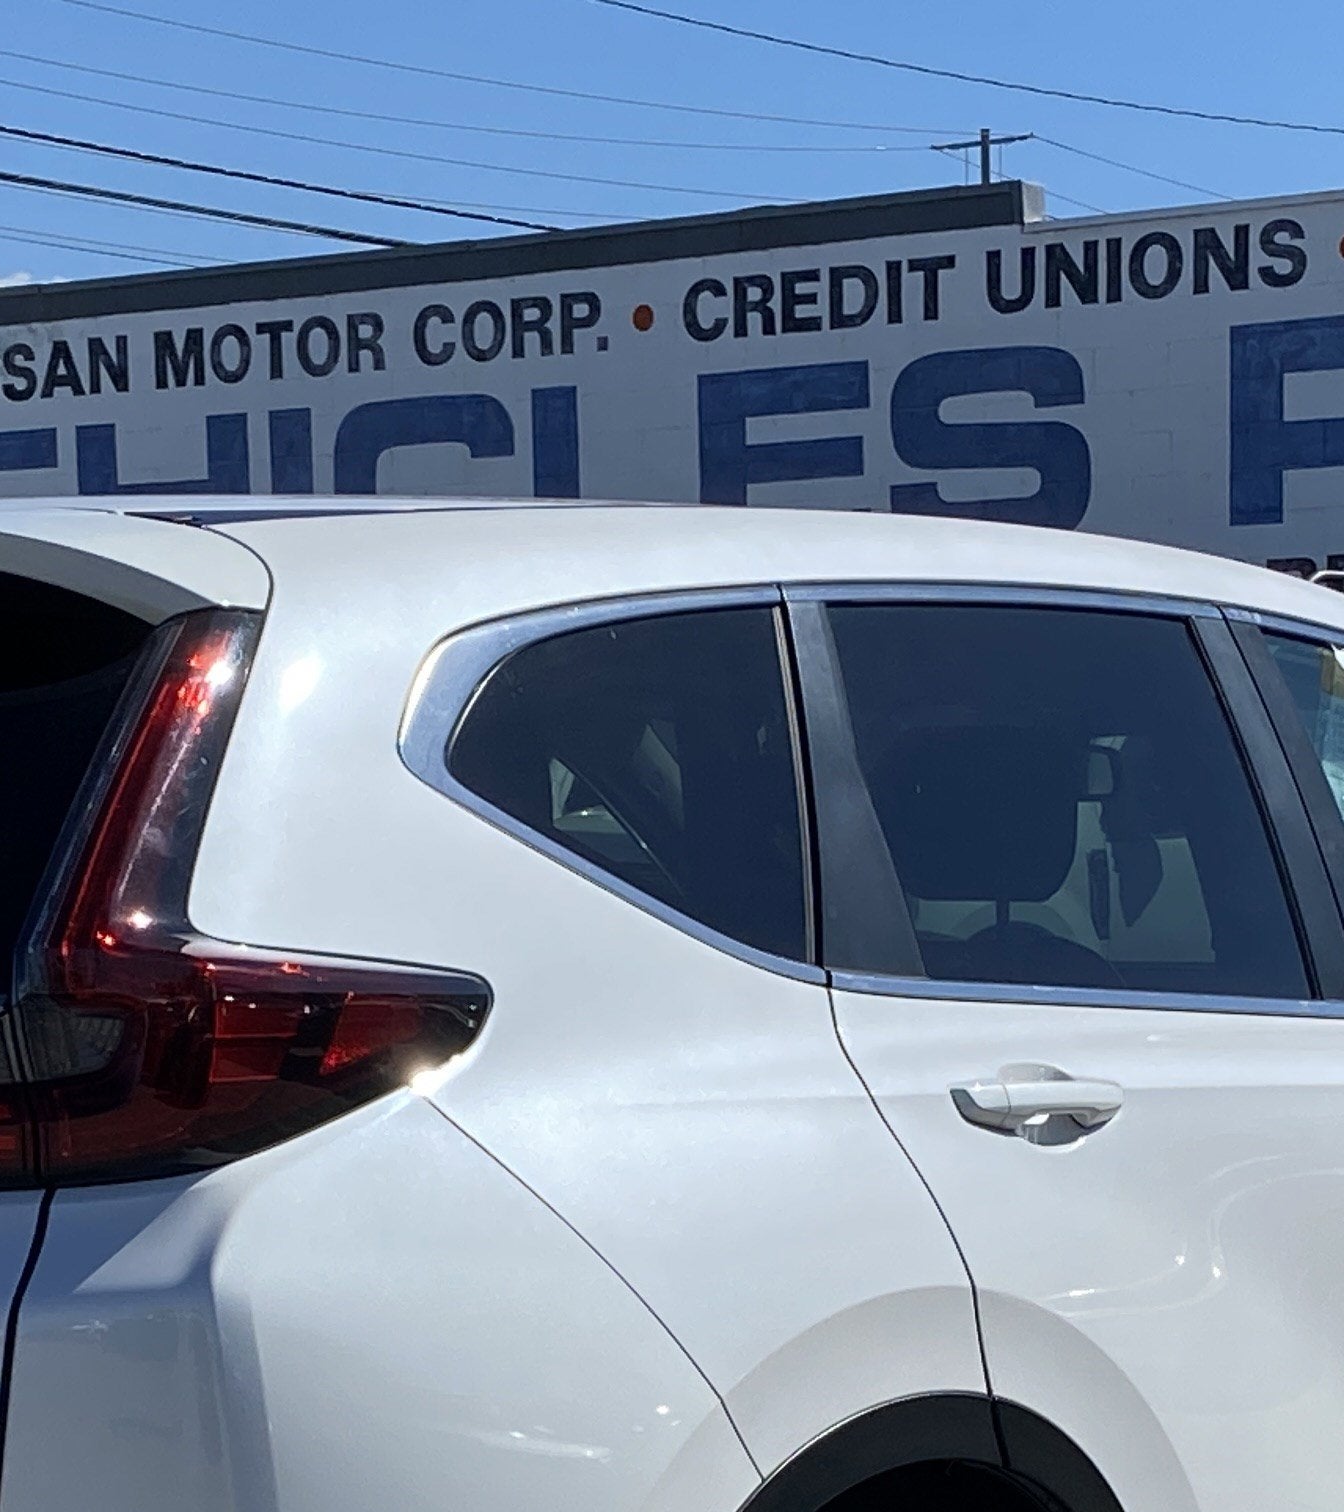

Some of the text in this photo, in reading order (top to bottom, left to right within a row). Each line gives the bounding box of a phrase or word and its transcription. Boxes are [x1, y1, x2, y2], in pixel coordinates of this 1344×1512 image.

[154, 312, 386, 390] MOTOR
[413, 291, 610, 366] CORP.
[682, 253, 956, 342] CREDIT
[985, 219, 1308, 314] UNIONS
